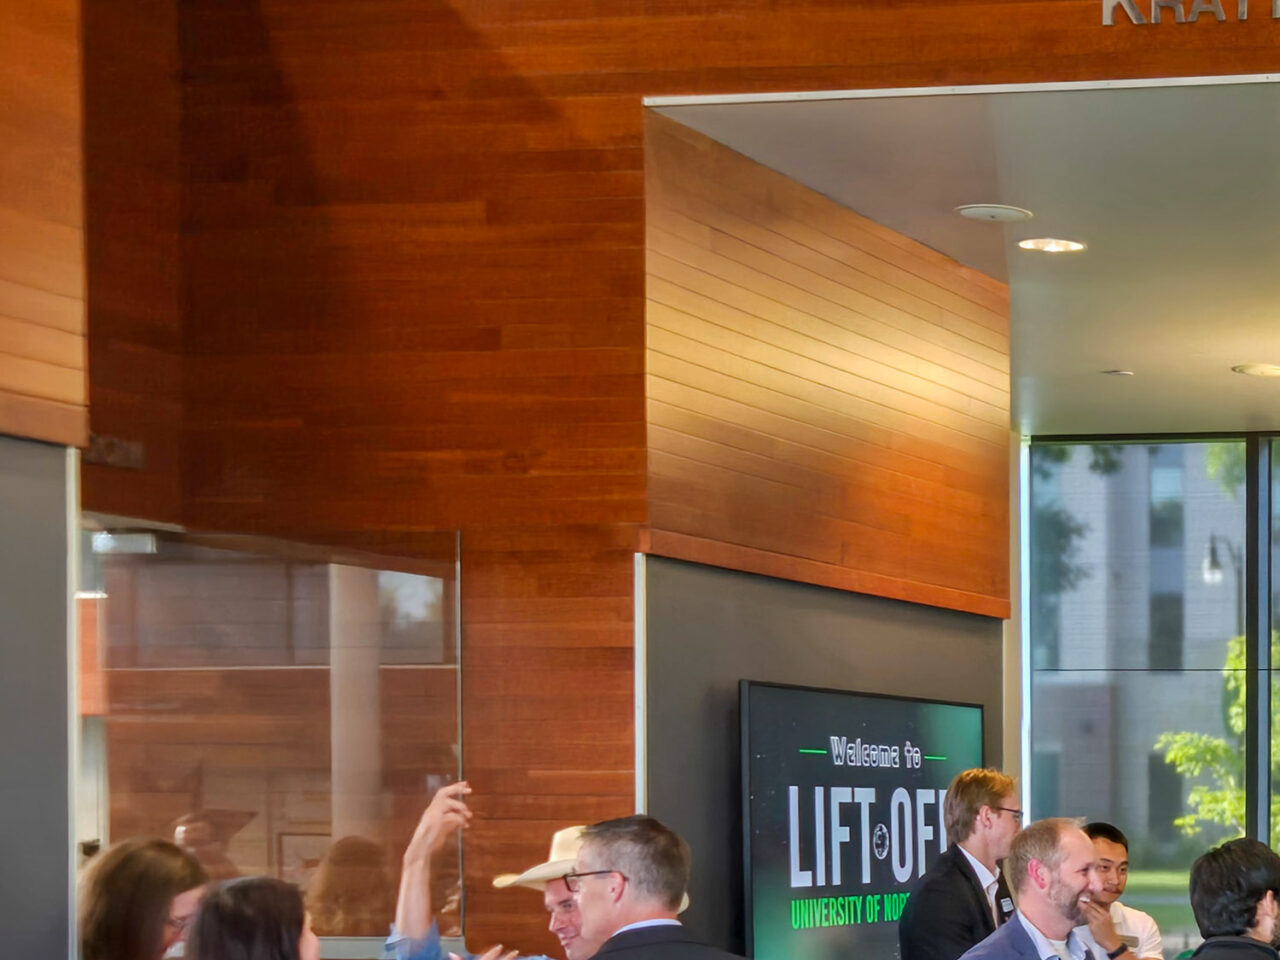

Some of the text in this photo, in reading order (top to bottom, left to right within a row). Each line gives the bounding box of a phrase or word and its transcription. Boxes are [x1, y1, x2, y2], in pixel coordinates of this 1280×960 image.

[830, 736, 922, 768] Welcome to
[789, 785, 876, 888] LIFT
[791, 893, 910, 930] UNIVERSITY OF NOR
